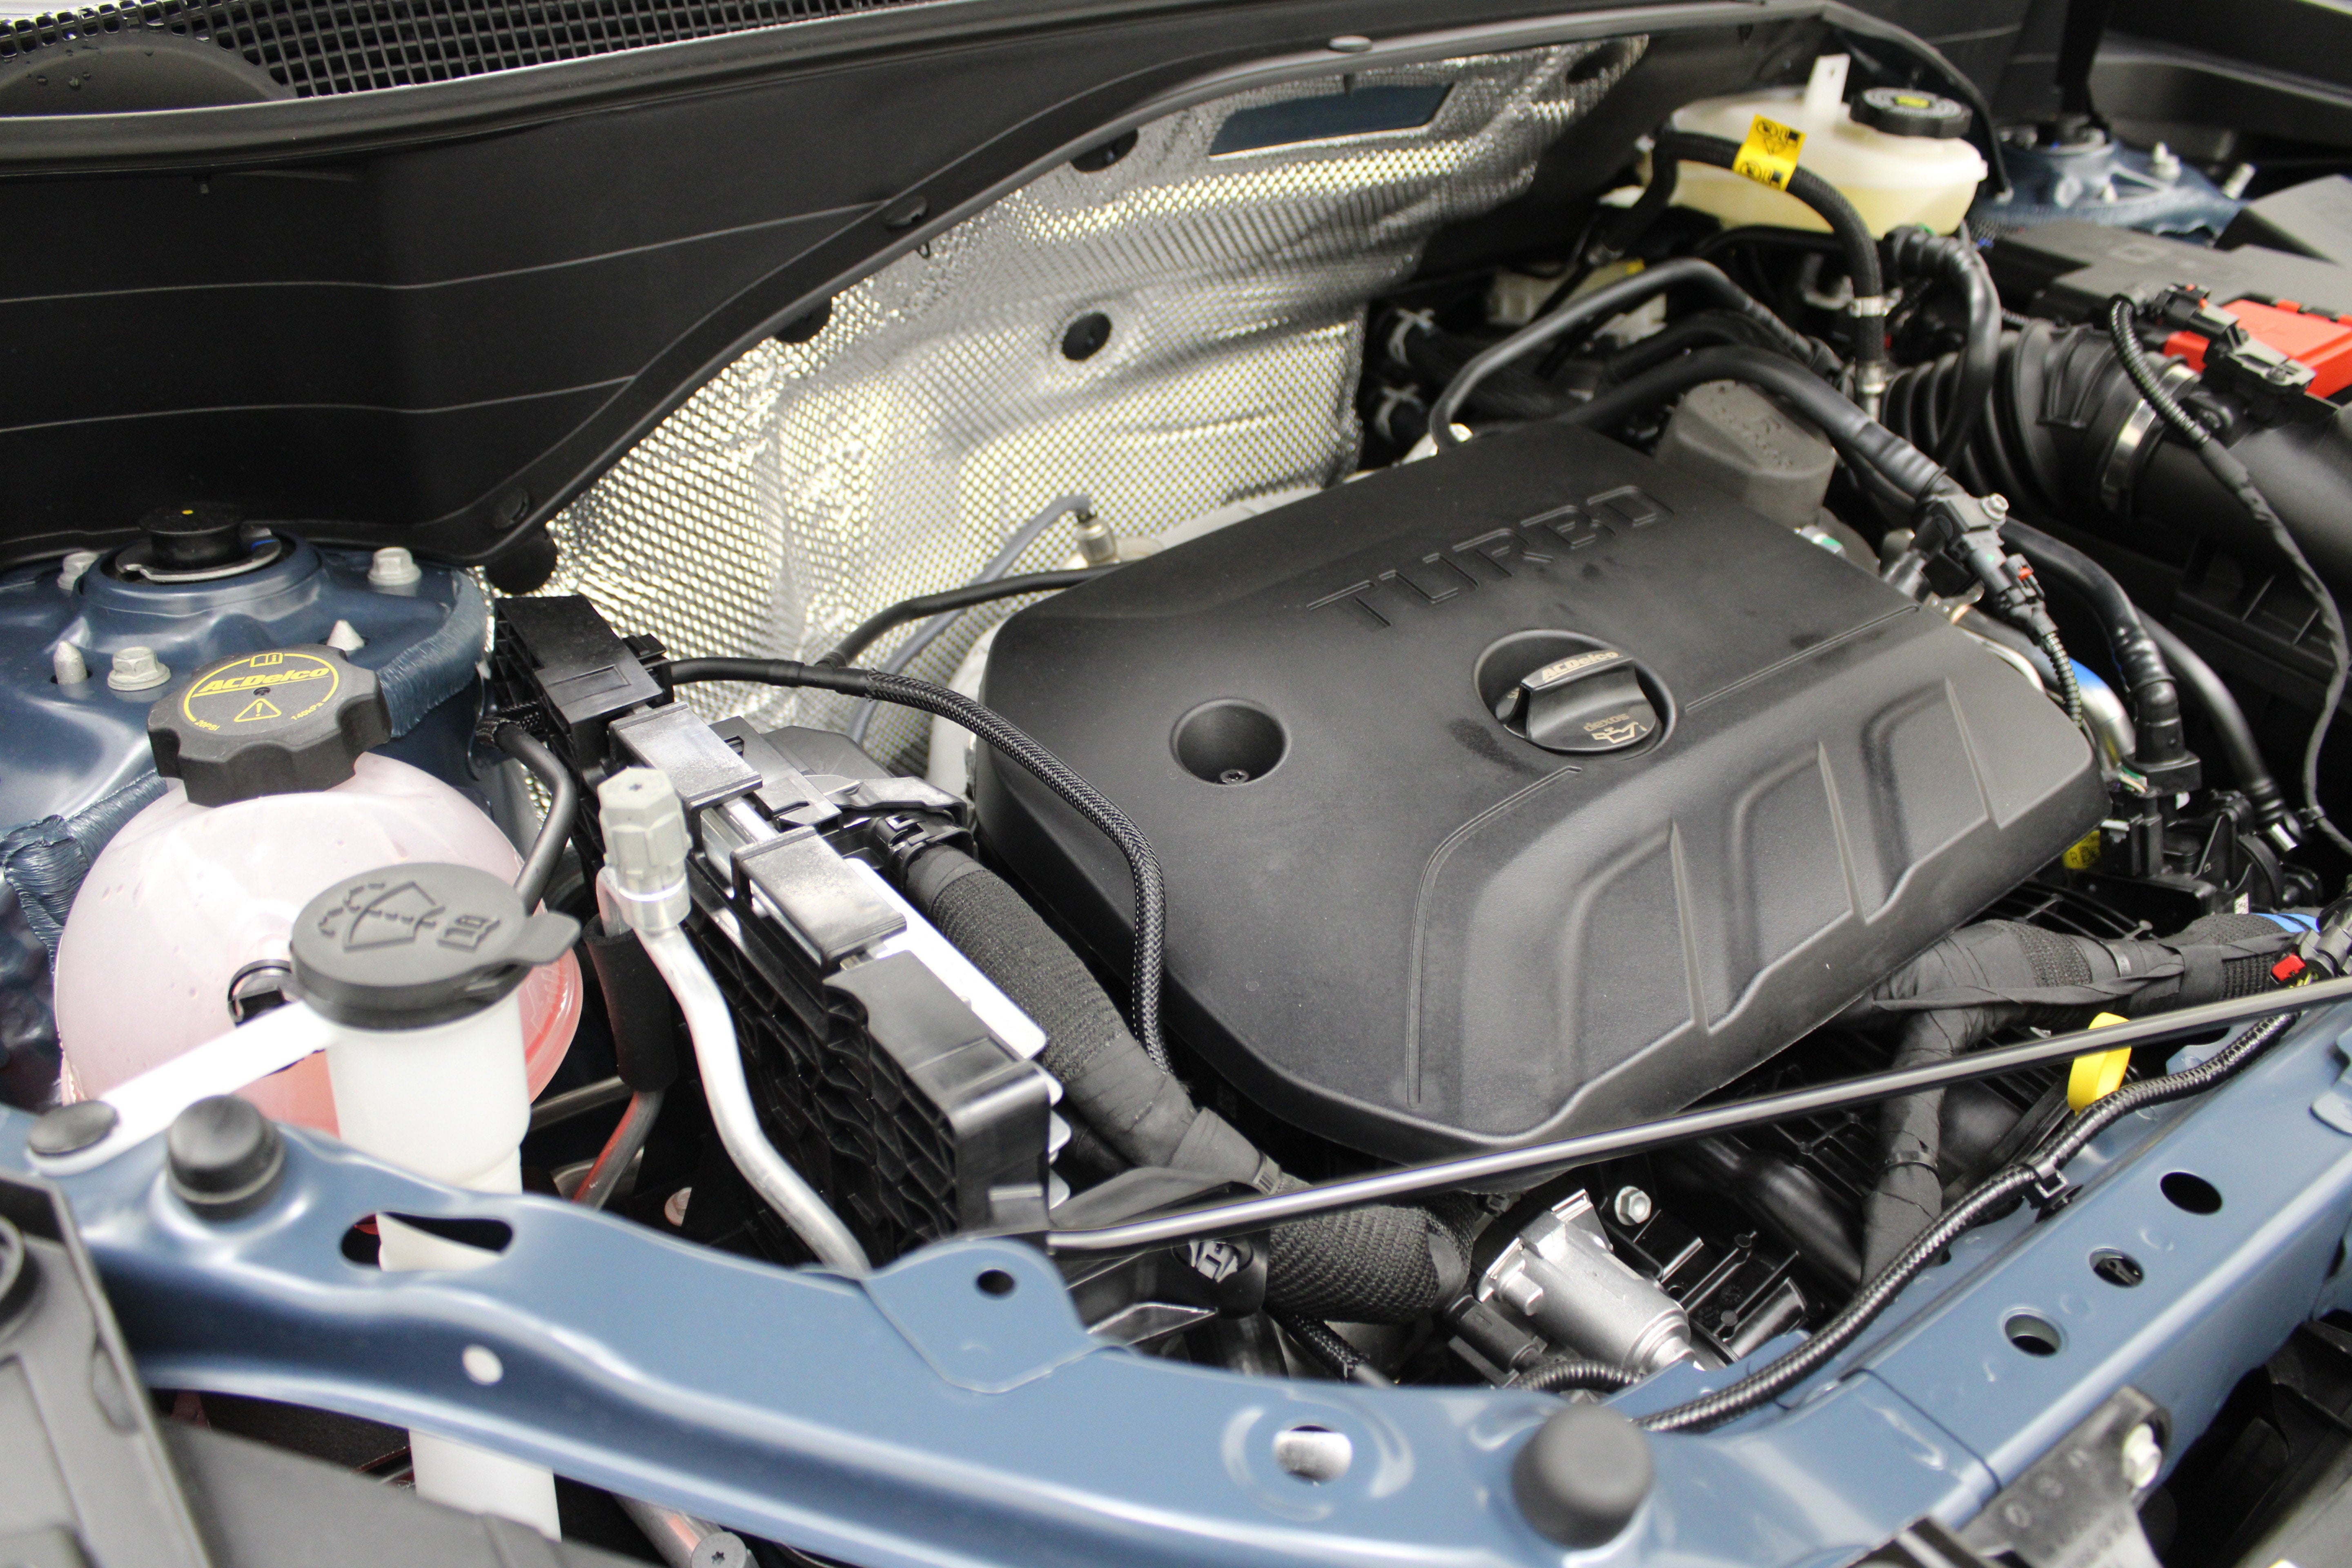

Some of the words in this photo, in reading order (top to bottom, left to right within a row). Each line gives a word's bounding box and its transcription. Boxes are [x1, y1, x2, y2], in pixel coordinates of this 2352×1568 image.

[1307, 485, 1675, 628] TURBO
[1542, 652, 1619, 681] ACDelco
[198, 668, 329, 693] ACDelco
[291, 702, 324, 720] 140kPa
[195, 720, 220, 731] 20PSI
[1584, 714, 1629, 732] dexos
